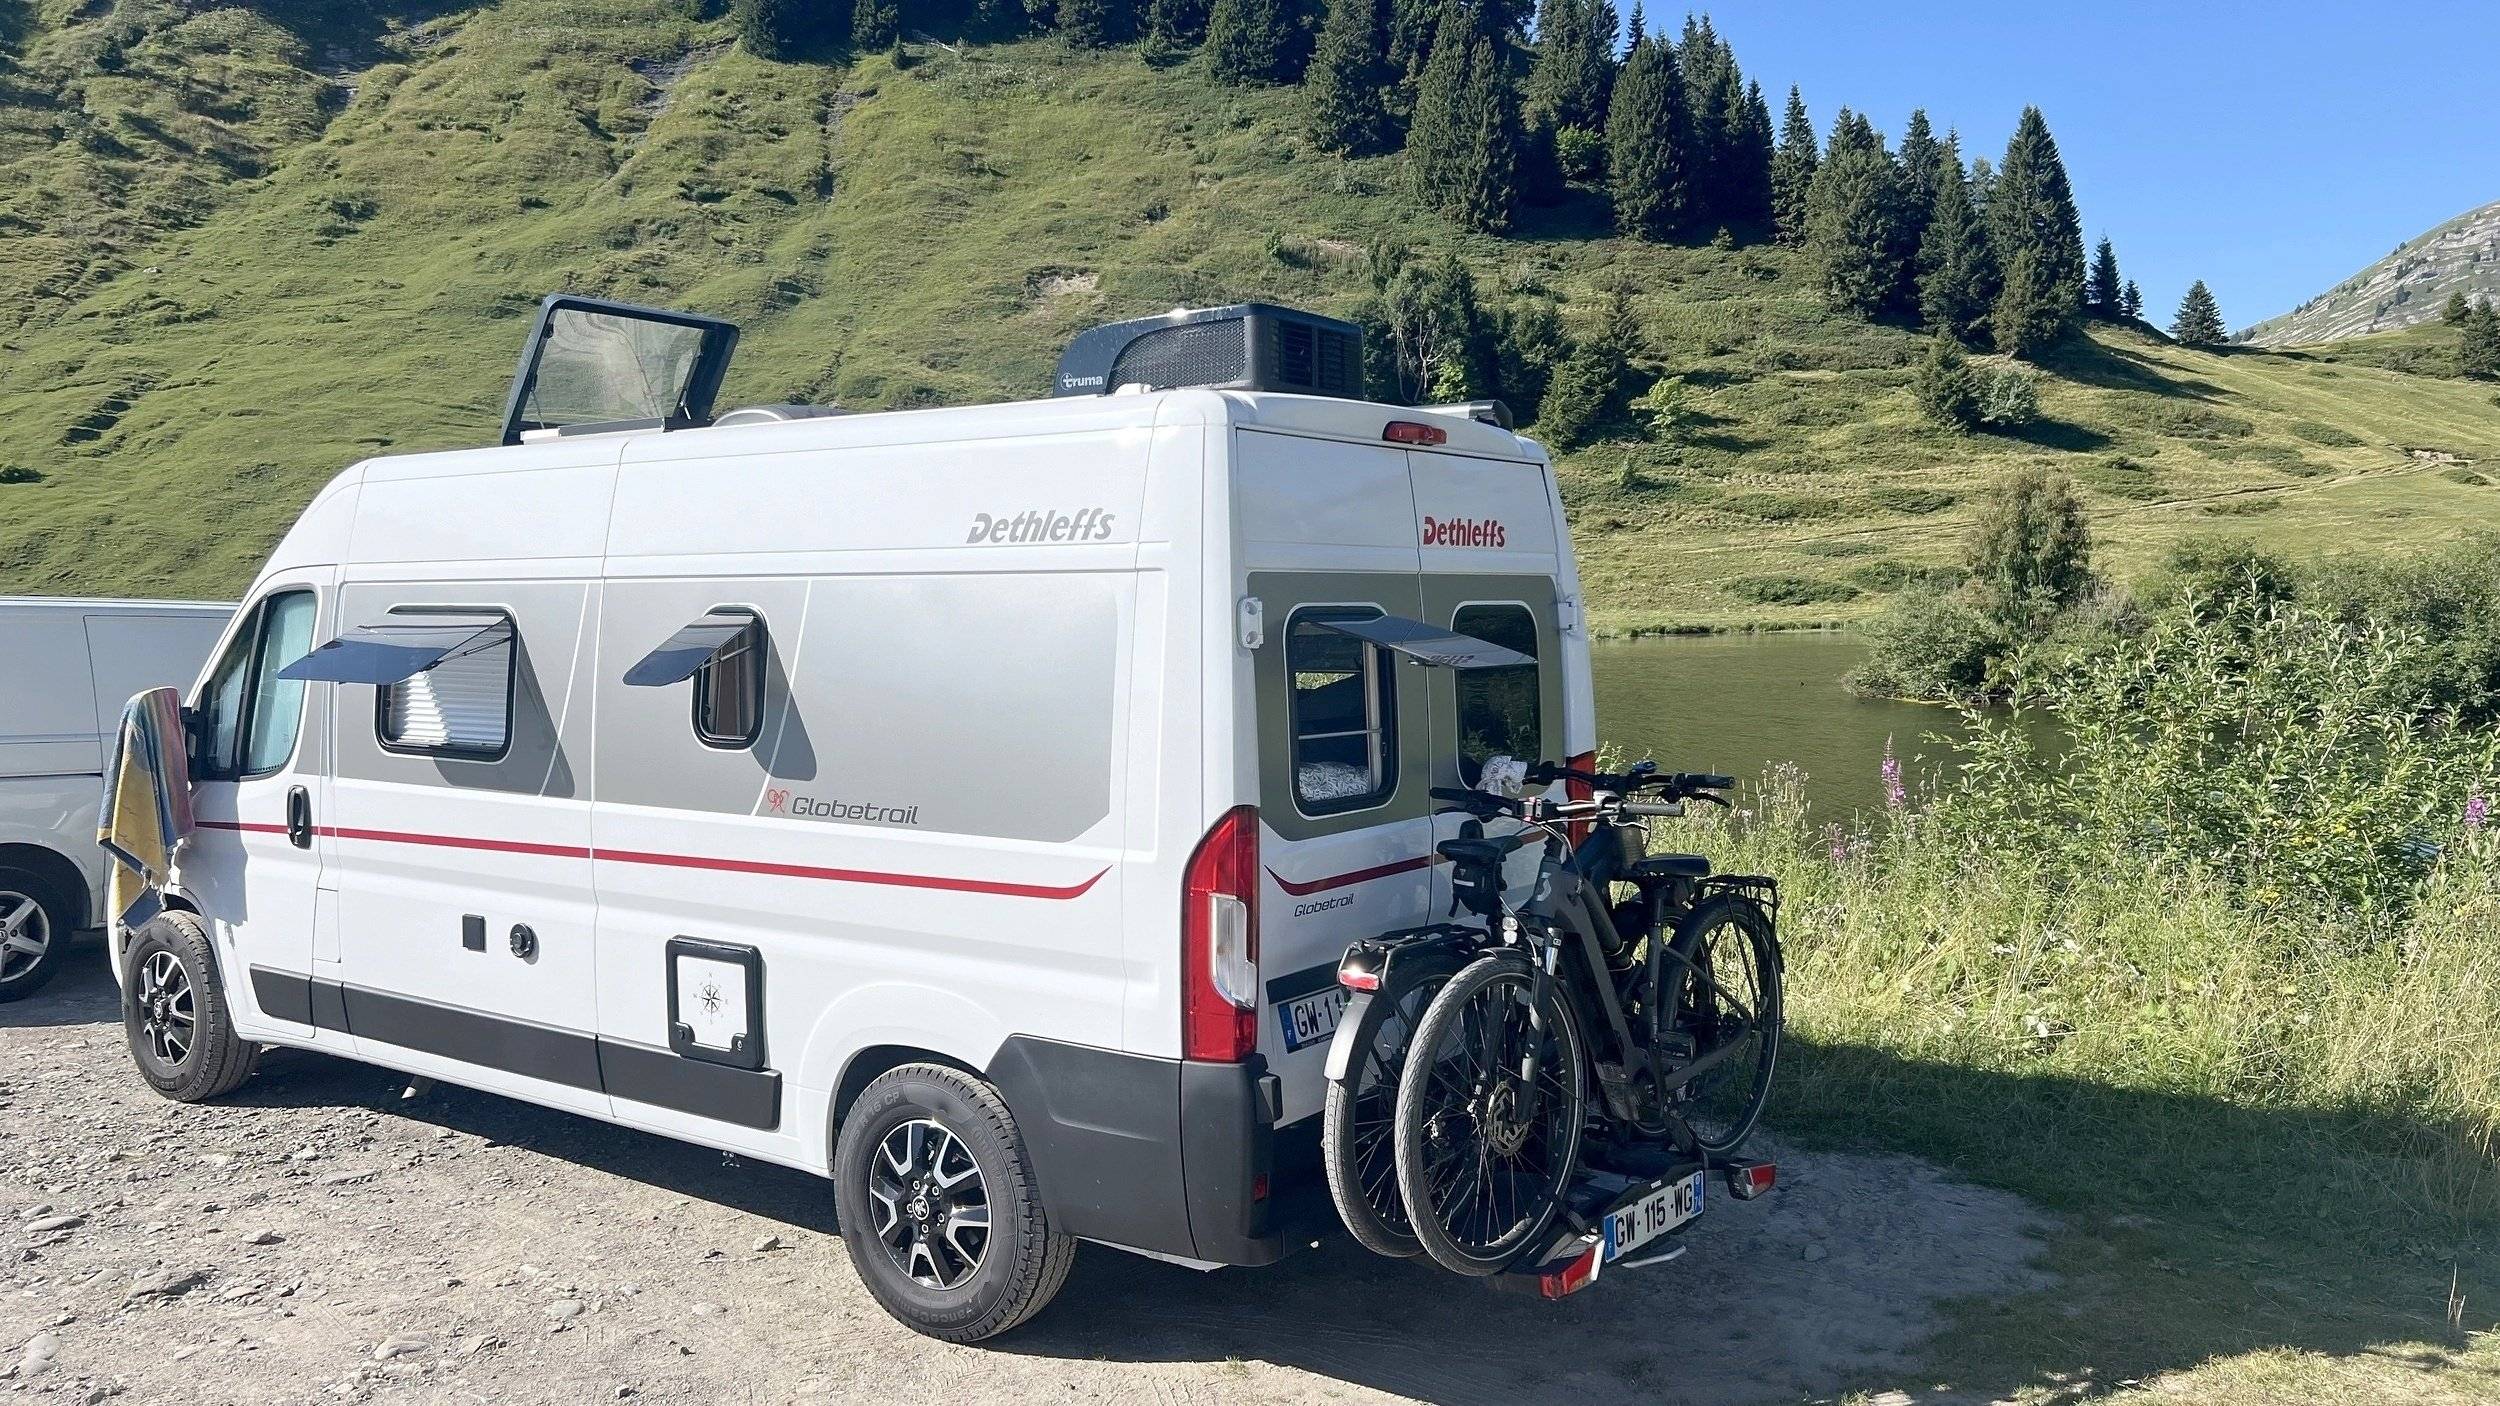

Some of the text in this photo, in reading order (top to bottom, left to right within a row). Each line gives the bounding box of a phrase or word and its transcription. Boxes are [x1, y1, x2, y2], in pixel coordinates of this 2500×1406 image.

[1062, 374, 1103, 388] truma
[966, 507, 1116, 544] Dethleffs
[1423, 516, 1505, 548] Dethleffs
[791, 797, 919, 825] Globetrail
[1294, 893, 1355, 917] Globetrail
